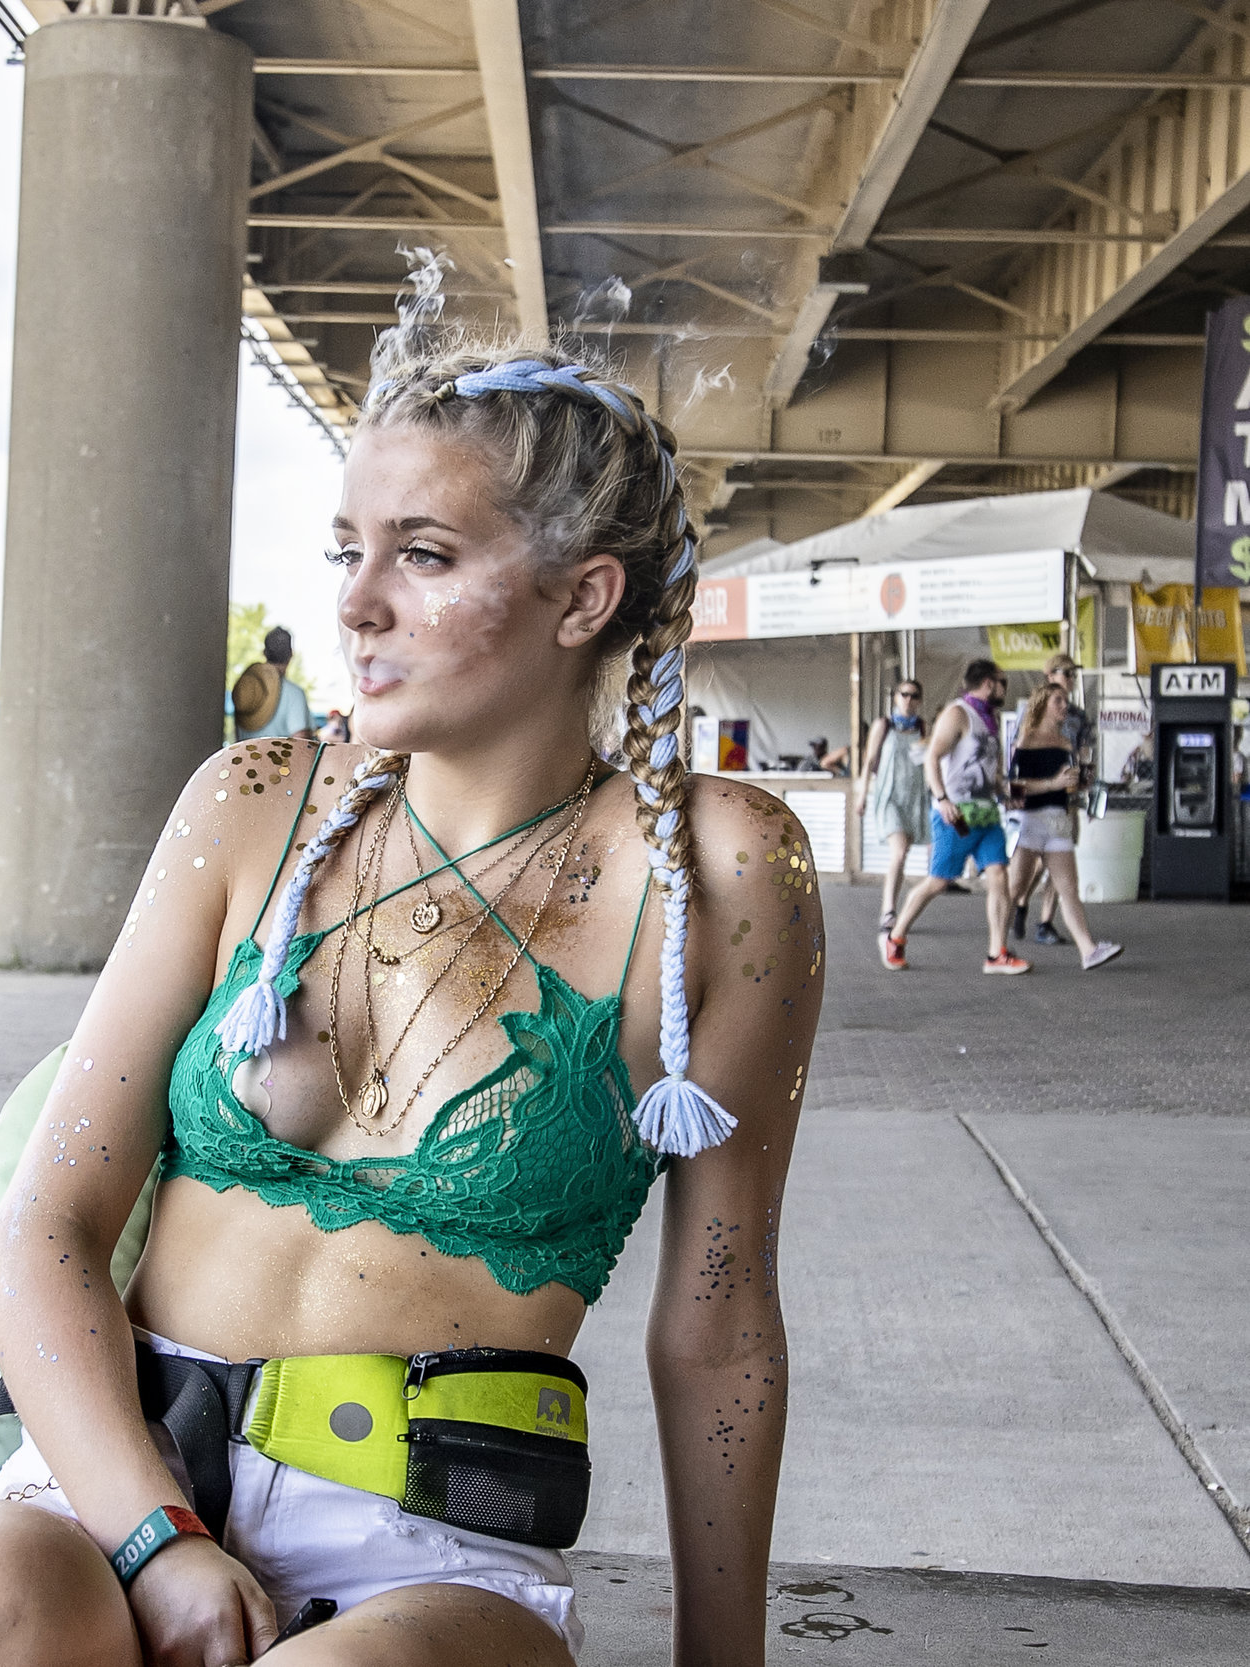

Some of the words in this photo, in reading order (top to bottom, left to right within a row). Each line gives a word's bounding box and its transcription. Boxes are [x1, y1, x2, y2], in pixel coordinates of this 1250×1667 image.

[1165, 672, 1221, 691] ATM
[1099, 711, 1148, 722] NATIONAL
[116, 1523, 156, 1575] 2019
